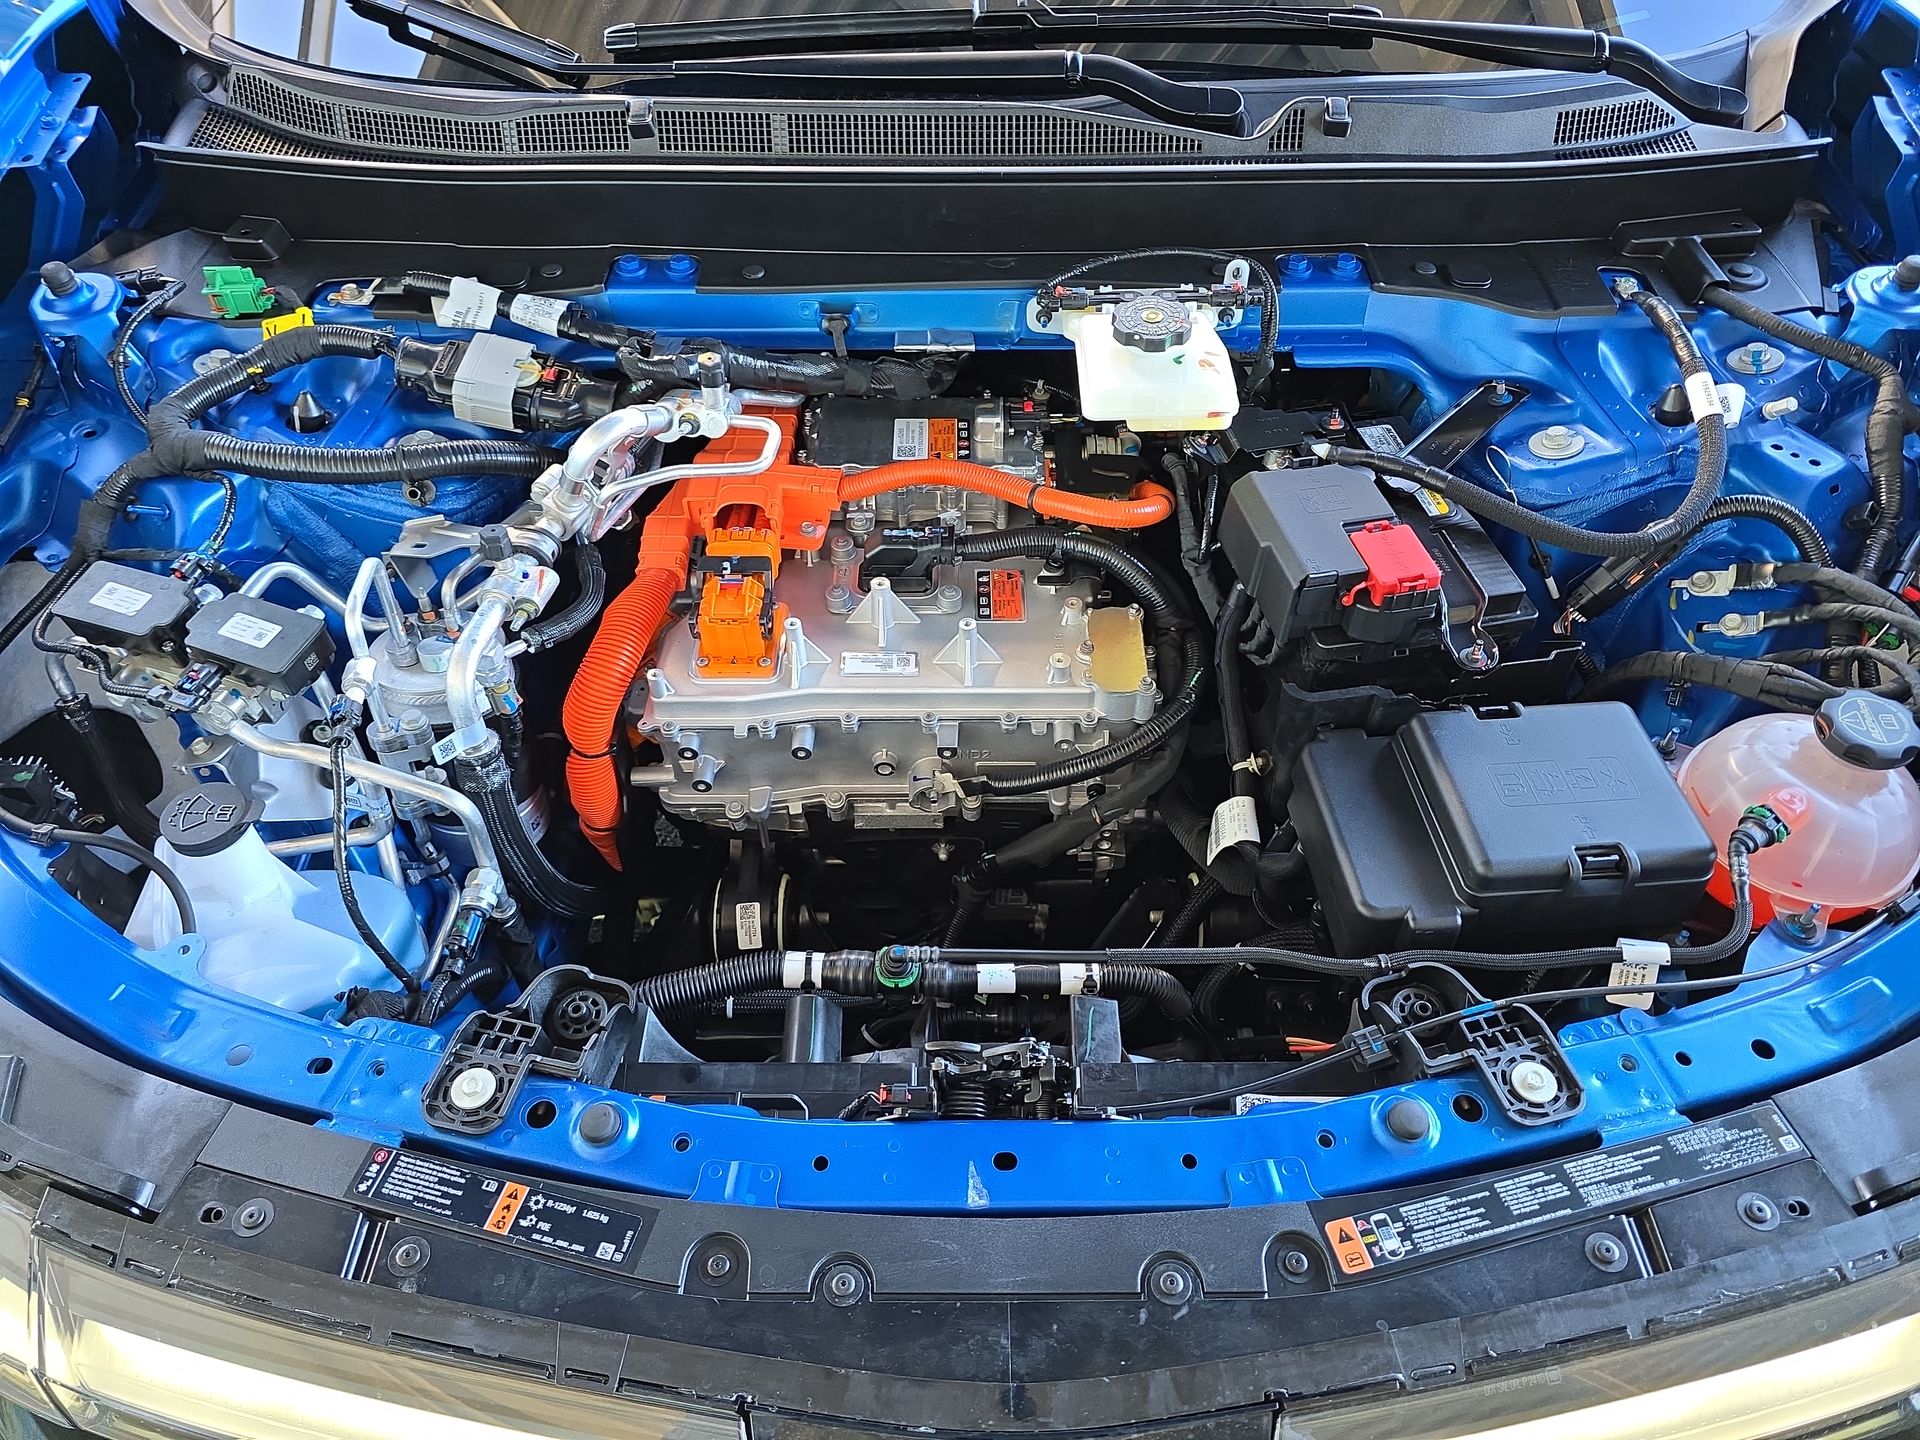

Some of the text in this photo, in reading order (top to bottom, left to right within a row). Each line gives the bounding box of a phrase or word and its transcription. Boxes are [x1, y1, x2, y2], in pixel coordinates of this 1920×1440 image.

[1857, 699, 1884, 742] ACDelco
[955, 749, 992, 760] ND2
[547, 1200, 609, 1223] R-1234yf 1.625 kg
[537, 1222, 551, 1231] POE
